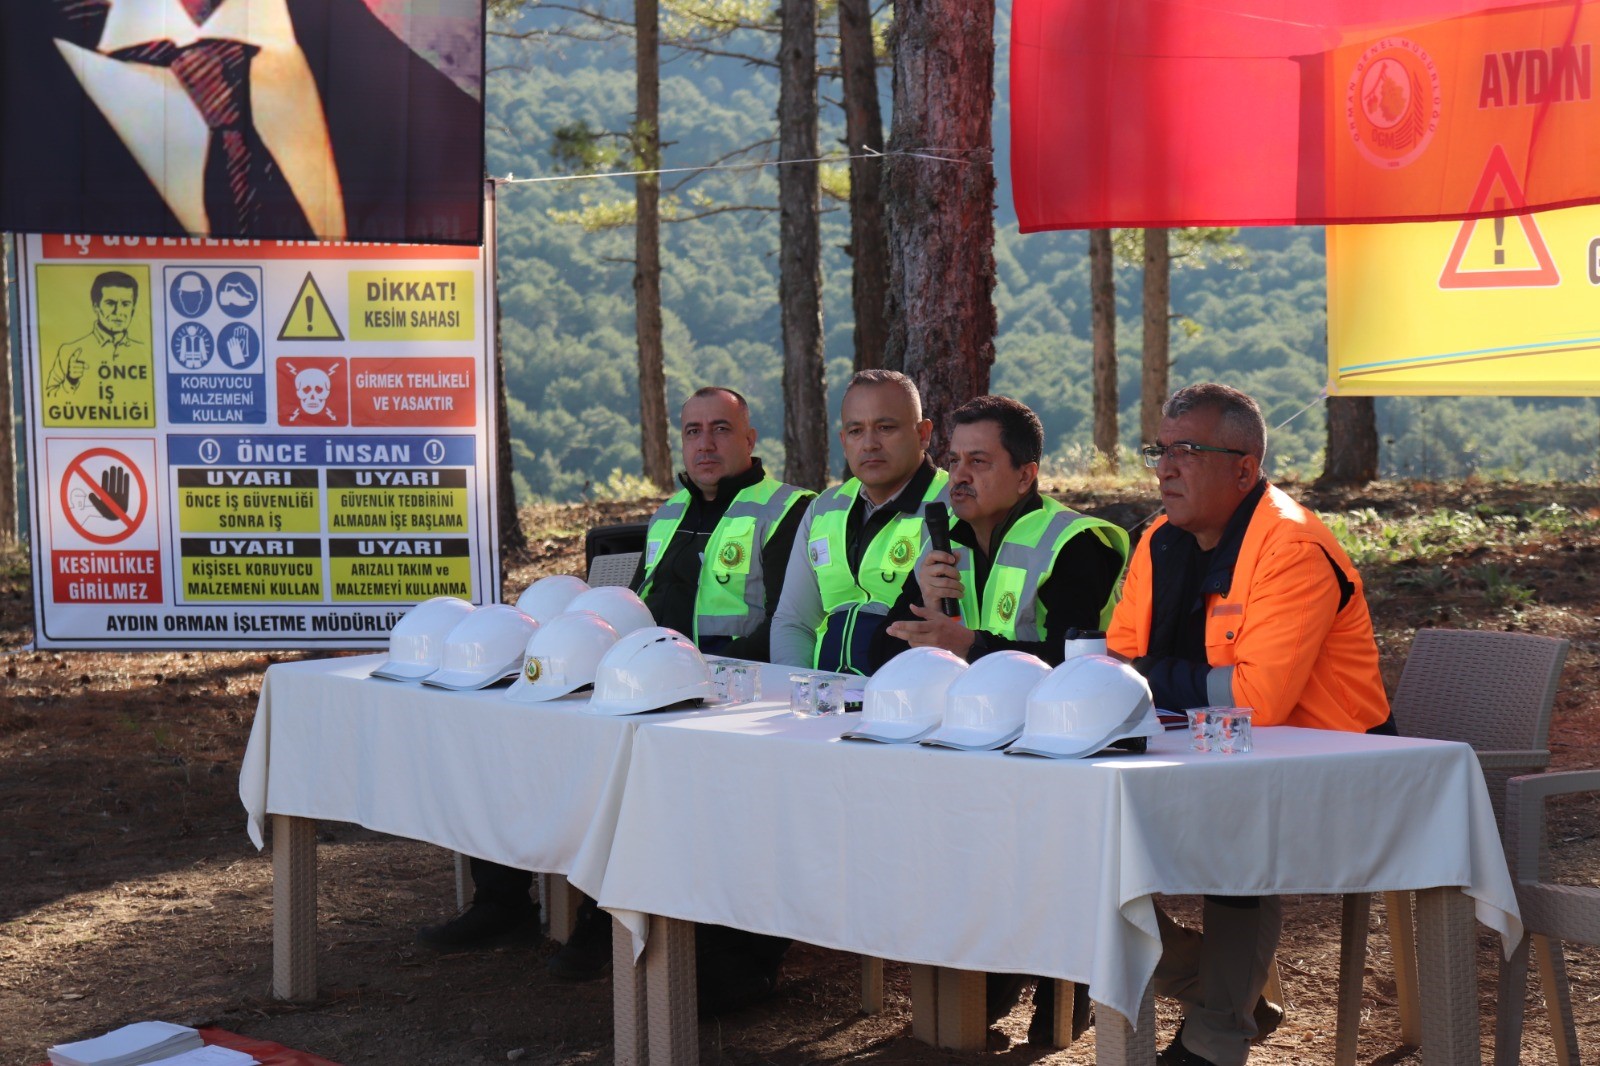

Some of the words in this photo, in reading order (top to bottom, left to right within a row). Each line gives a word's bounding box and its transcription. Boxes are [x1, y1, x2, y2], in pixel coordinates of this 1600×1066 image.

[1478, 44, 1592, 109] AYDIN
[367, 277, 456, 301] DİKKAT!
[365, 307, 406, 328] KESİM
[411, 311, 460, 328] SAHASI
[98, 361, 147, 380] ÖNCE
[356, 371, 404, 388] GİRMEK
[407, 370, 470, 388] TEHLİKELİ
[181, 376, 252, 389] KORUYUCU
[98, 382, 114, 404] İŞ
[181, 391, 254, 406] MALZEMENİ
[48, 402, 149, 421] GÜVENLİĞİ
[373, 396, 389, 410] VE
[392, 396, 454, 410] YASAKTIR
[192, 409, 243, 422] KULLAN
[237, 439, 307, 463] ÖNCE
[326, 439, 410, 463] İNSAN
[207, 471, 292, 485] UYARI
[355, 471, 440, 486] UYARI
[186, 491, 221, 508] ÖNCE
[226, 491, 239, 511] İŞ
[243, 491, 314, 508] GÜVENLİĞİ
[341, 491, 395, 507] GÜVENLİK
[398, 491, 454, 507] TEDBİRİNİ
[219, 514, 265, 528] SONRA
[269, 511, 282, 532] İŞ
[333, 514, 387, 527] ALMADAN
[390, 510, 407, 531] İŞE
[411, 514, 463, 531] BAŞLAMA
[210, 540, 295, 555] UYARI
[358, 540, 442, 555] UYARI
[59, 552, 154, 574] KESİNLİKLE
[192, 559, 241, 579] KİŞİSEL
[246, 563, 313, 576] KORUYUCU
[351, 563, 394, 576] ARIZALI
[397, 563, 432, 576] TAKIM
[436, 566, 449, 576] ve
[69, 578, 148, 600] GİRİLMEZ
[188, 579, 266, 595] MALZEMENİ
[270, 583, 319, 595] KULLAN
[336, 579, 402, 595] MALZEMEYİ
[405, 582, 467, 595] KULLANMA
[106, 615, 158, 631] AYDIN
[163, 615, 228, 631] ORMAN
[234, 612, 306, 633] İŞLETME
